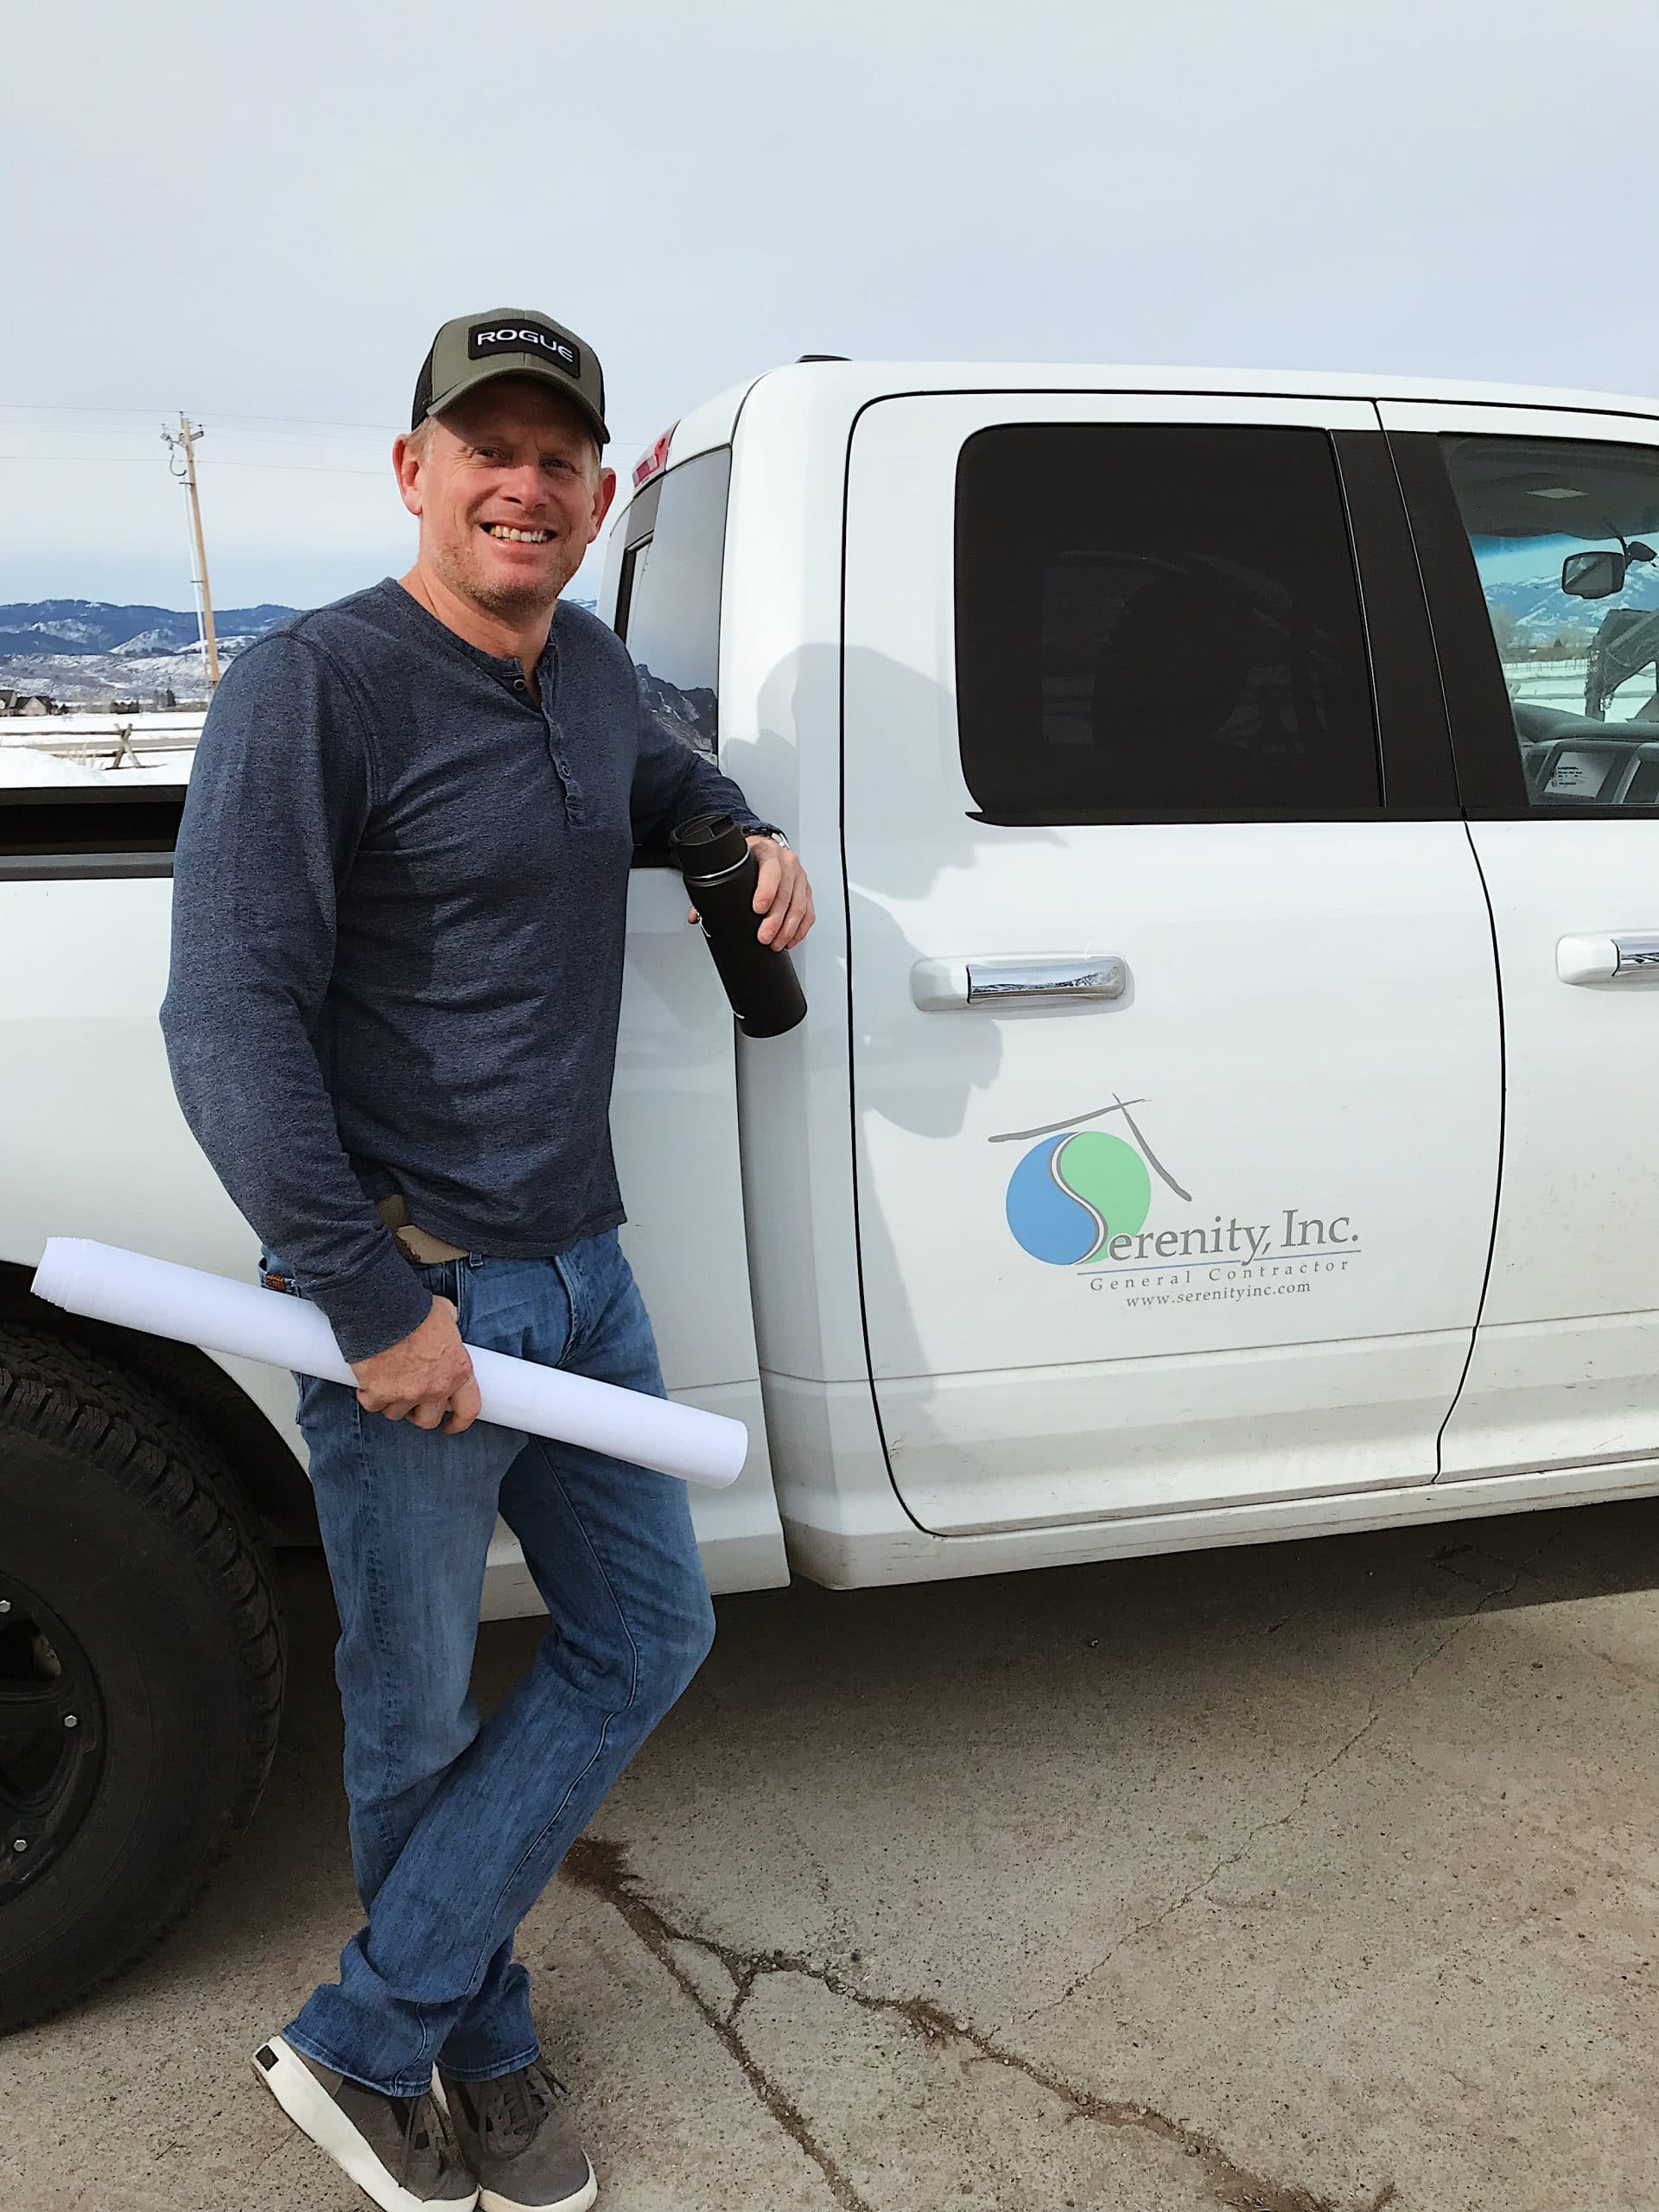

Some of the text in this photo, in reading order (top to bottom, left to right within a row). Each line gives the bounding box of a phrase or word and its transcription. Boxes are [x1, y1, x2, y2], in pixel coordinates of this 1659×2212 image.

[477, 329, 574, 363] ROGUE
[1280, 1209, 1359, 1248] Inc.
[1090, 1261, 1349, 1291] General Contractor
[1126, 1282, 1312, 1307] www.serenityinc.com
